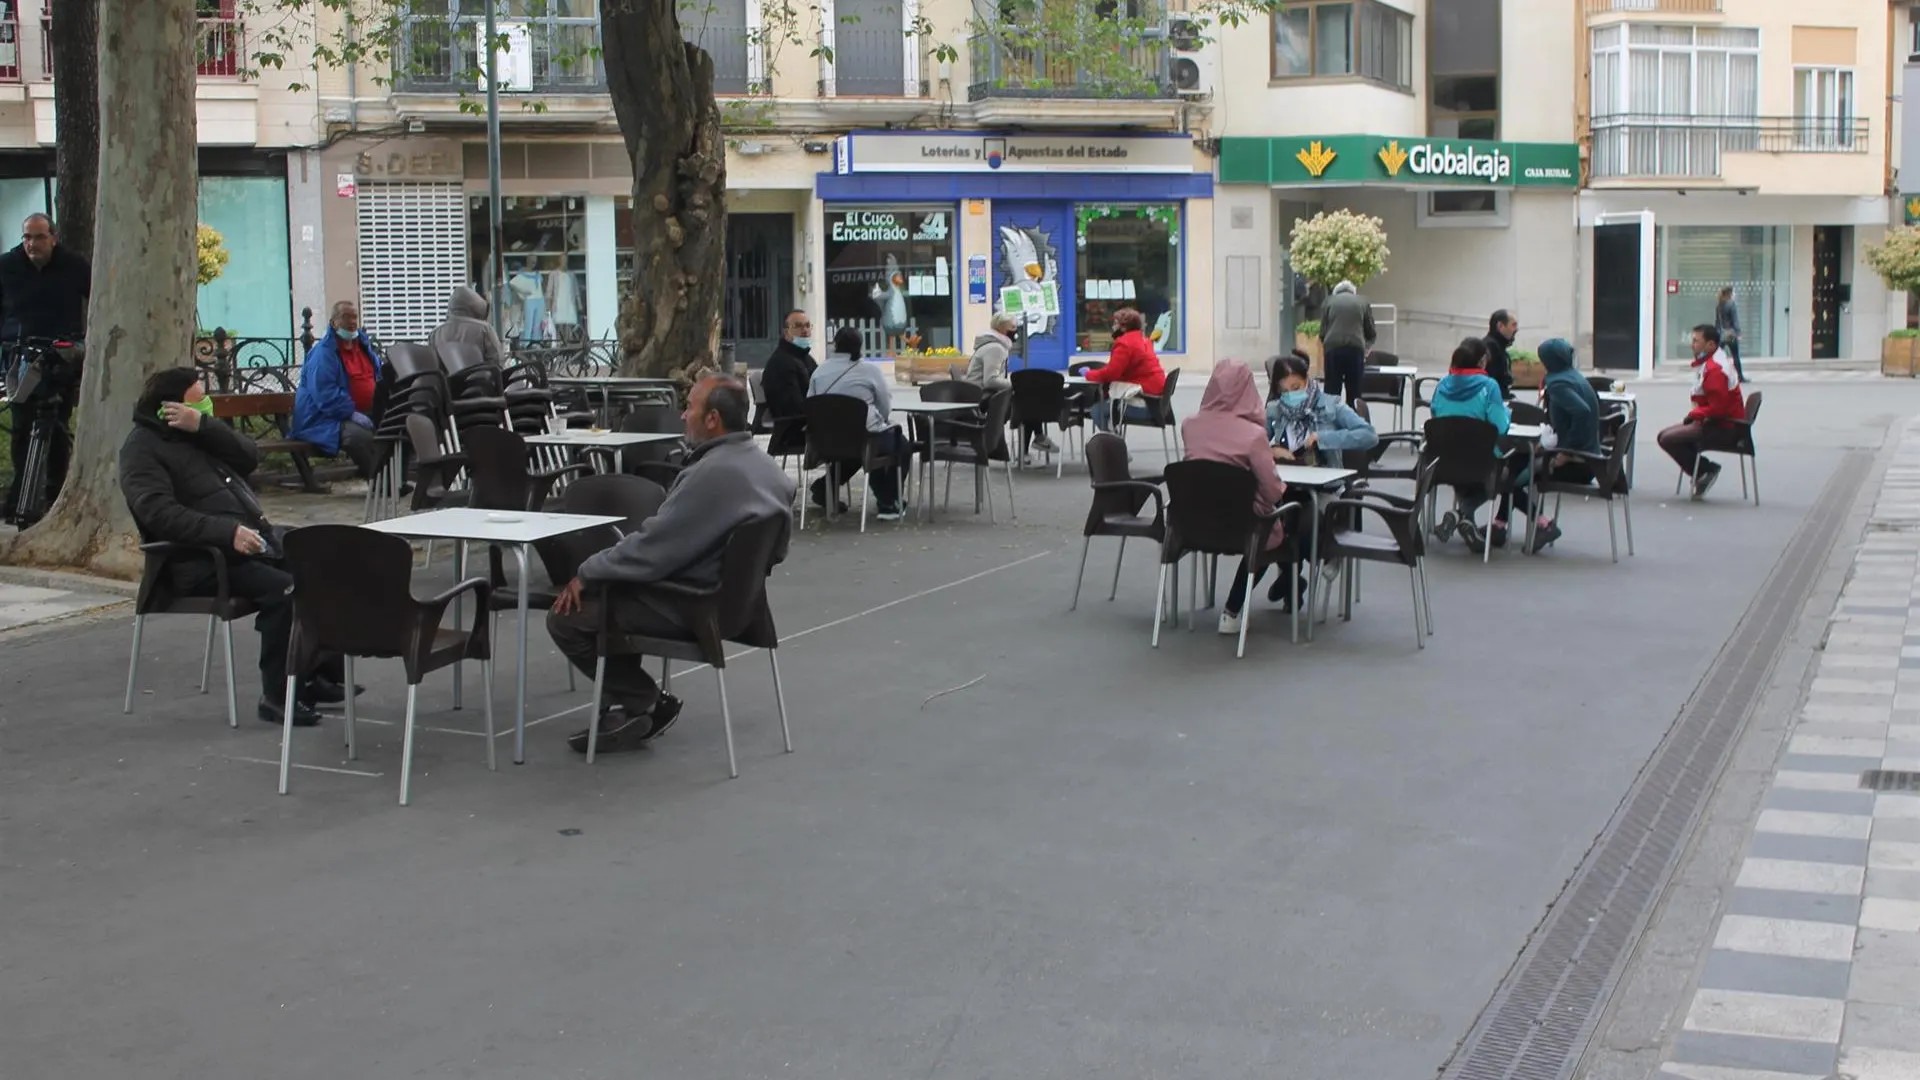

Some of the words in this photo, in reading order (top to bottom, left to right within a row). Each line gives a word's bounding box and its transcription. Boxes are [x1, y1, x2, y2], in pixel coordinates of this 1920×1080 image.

[921, 144, 970, 158] Loterías
[974, 147, 981, 160] y
[1008, 145, 1064, 160] Apuestas
[1066, 145, 1085, 158] del
[1088, 145, 1128, 158] Estado
[1408, 143, 1510, 183] Globalcaja
[1524, 168, 1545, 178] CAJA
[1545, 168, 1572, 178] RURAL
[845, 211, 859, 226] El
[862, 211, 895, 226] Cuco
[922, 212, 949, 240] 4
[832, 221, 909, 241] Encantado
